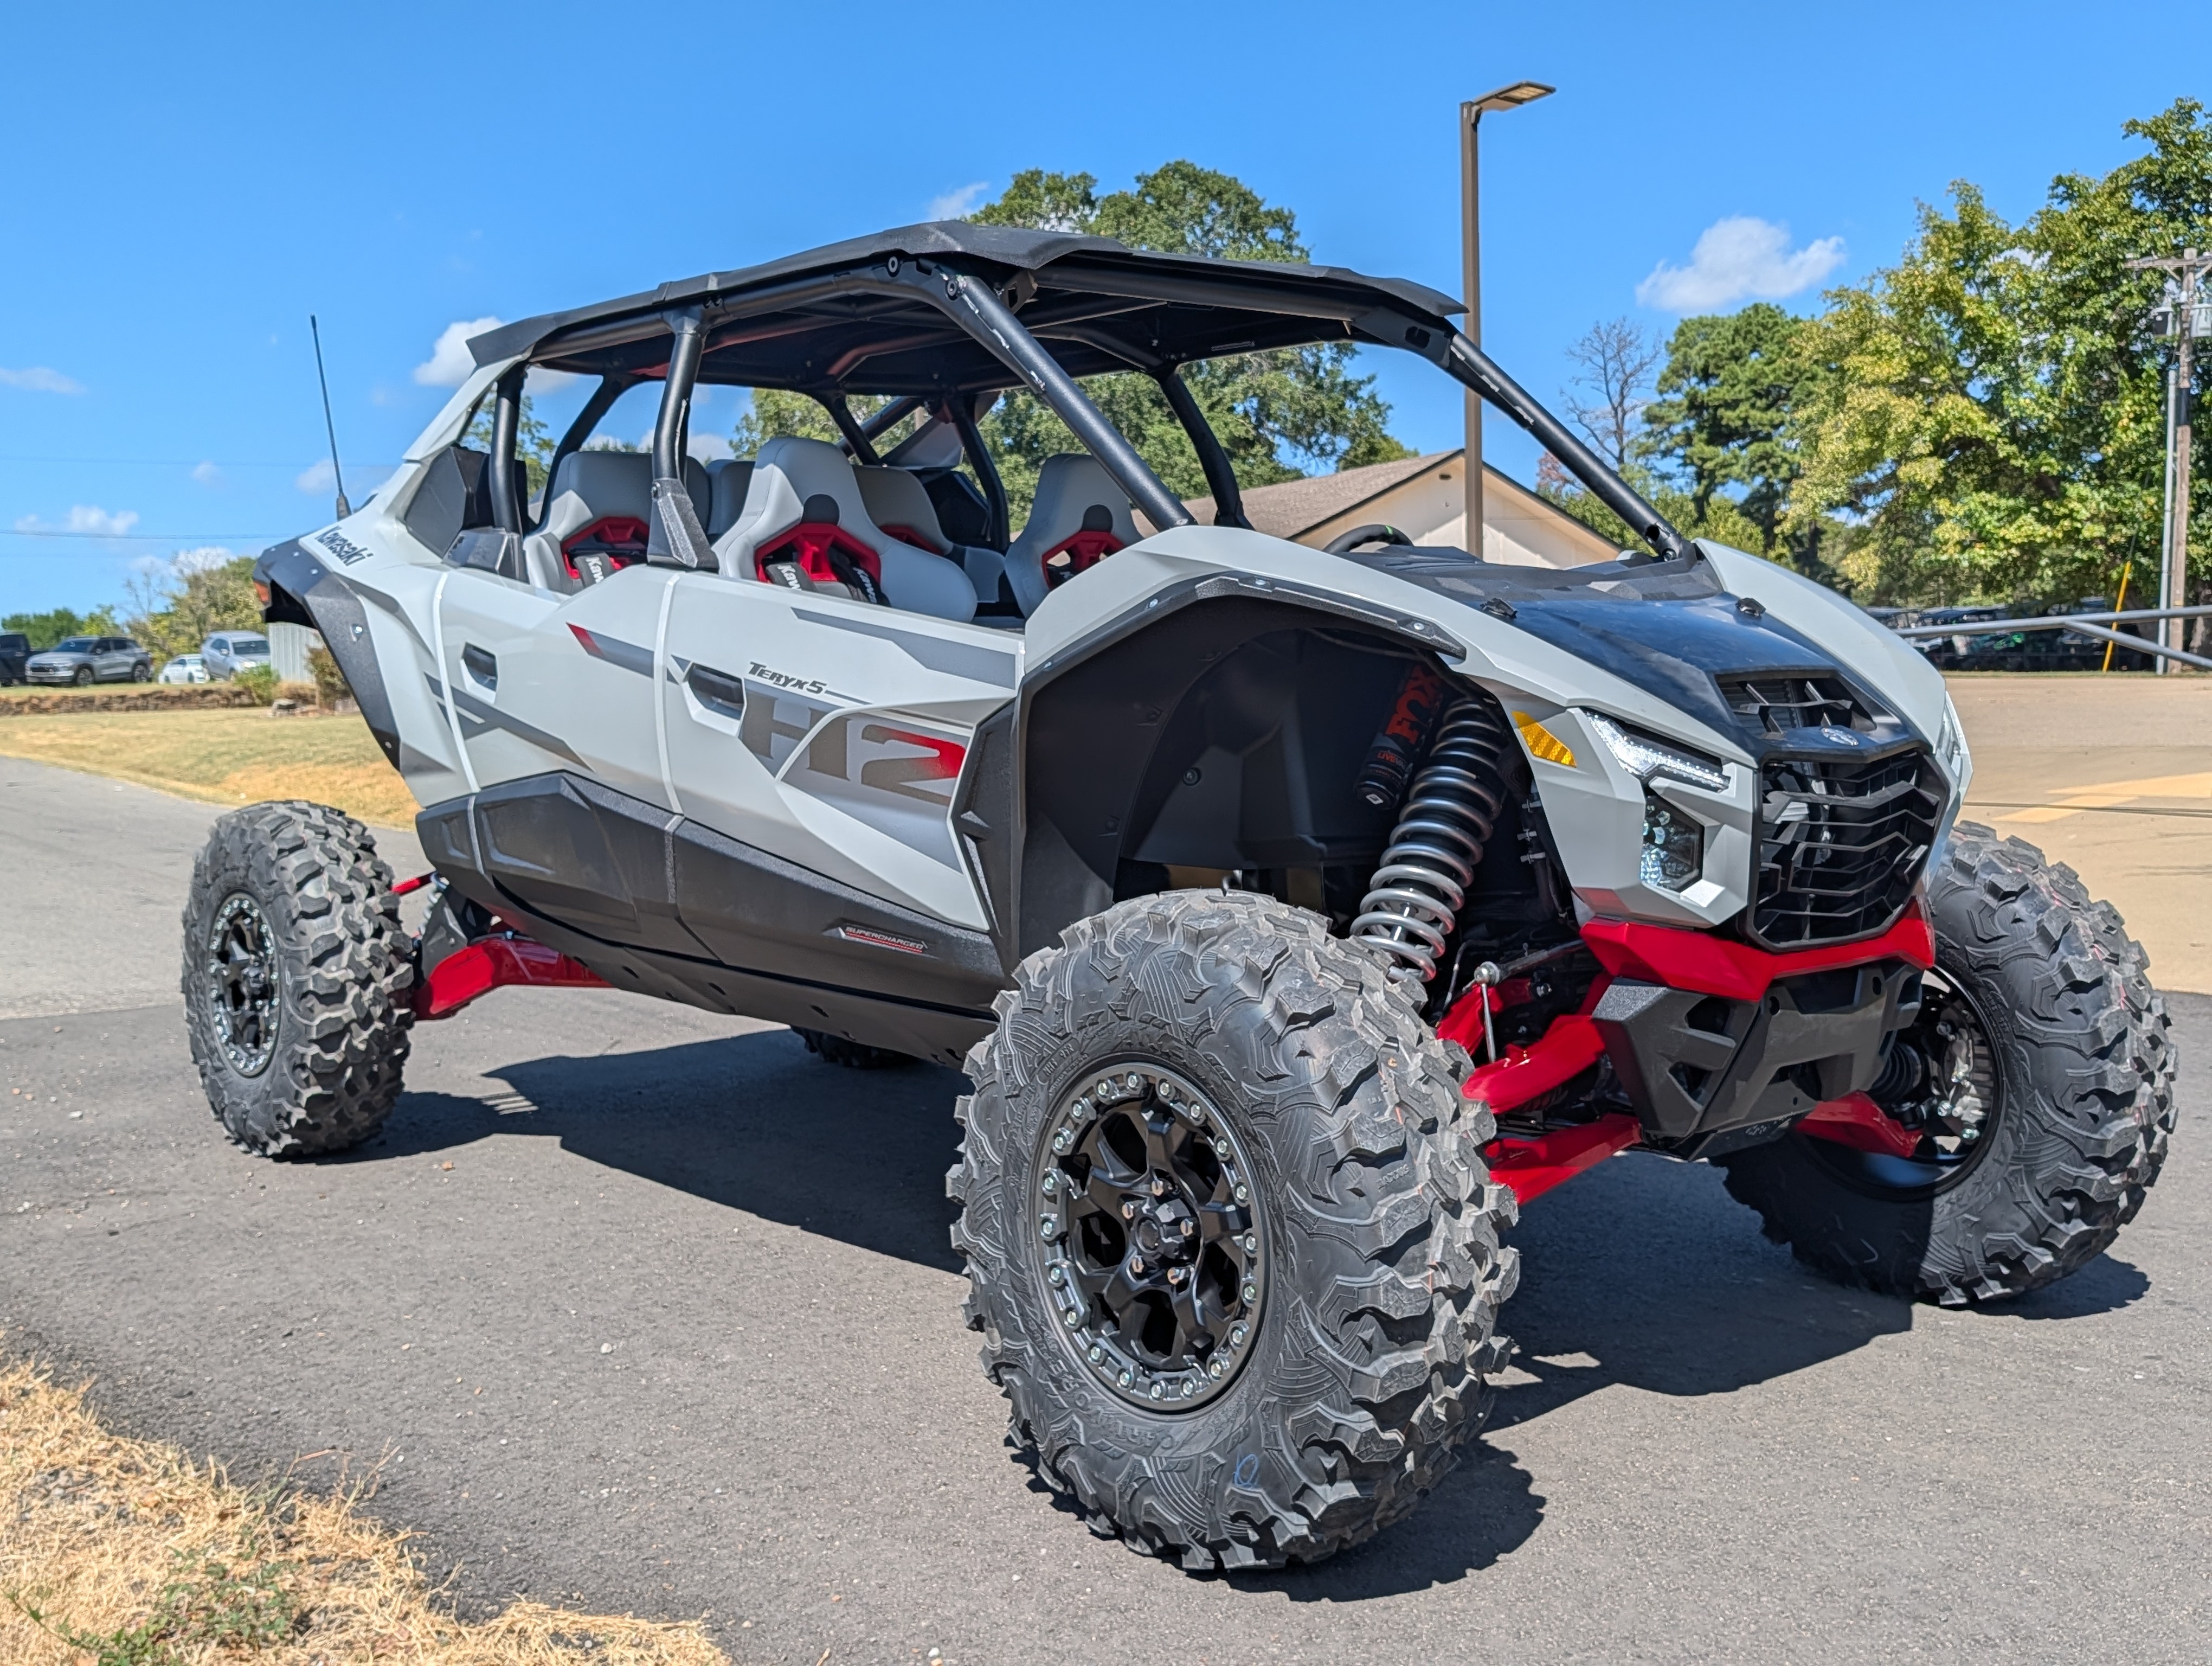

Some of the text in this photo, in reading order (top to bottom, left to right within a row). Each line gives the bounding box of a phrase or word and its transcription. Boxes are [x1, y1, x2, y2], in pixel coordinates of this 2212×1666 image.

[314, 526, 374, 567] Kawasaki
[1385, 664, 1442, 744] FOX
[742, 690, 966, 807] H2
[845, 926, 924, 950] SUPERCHARGED
